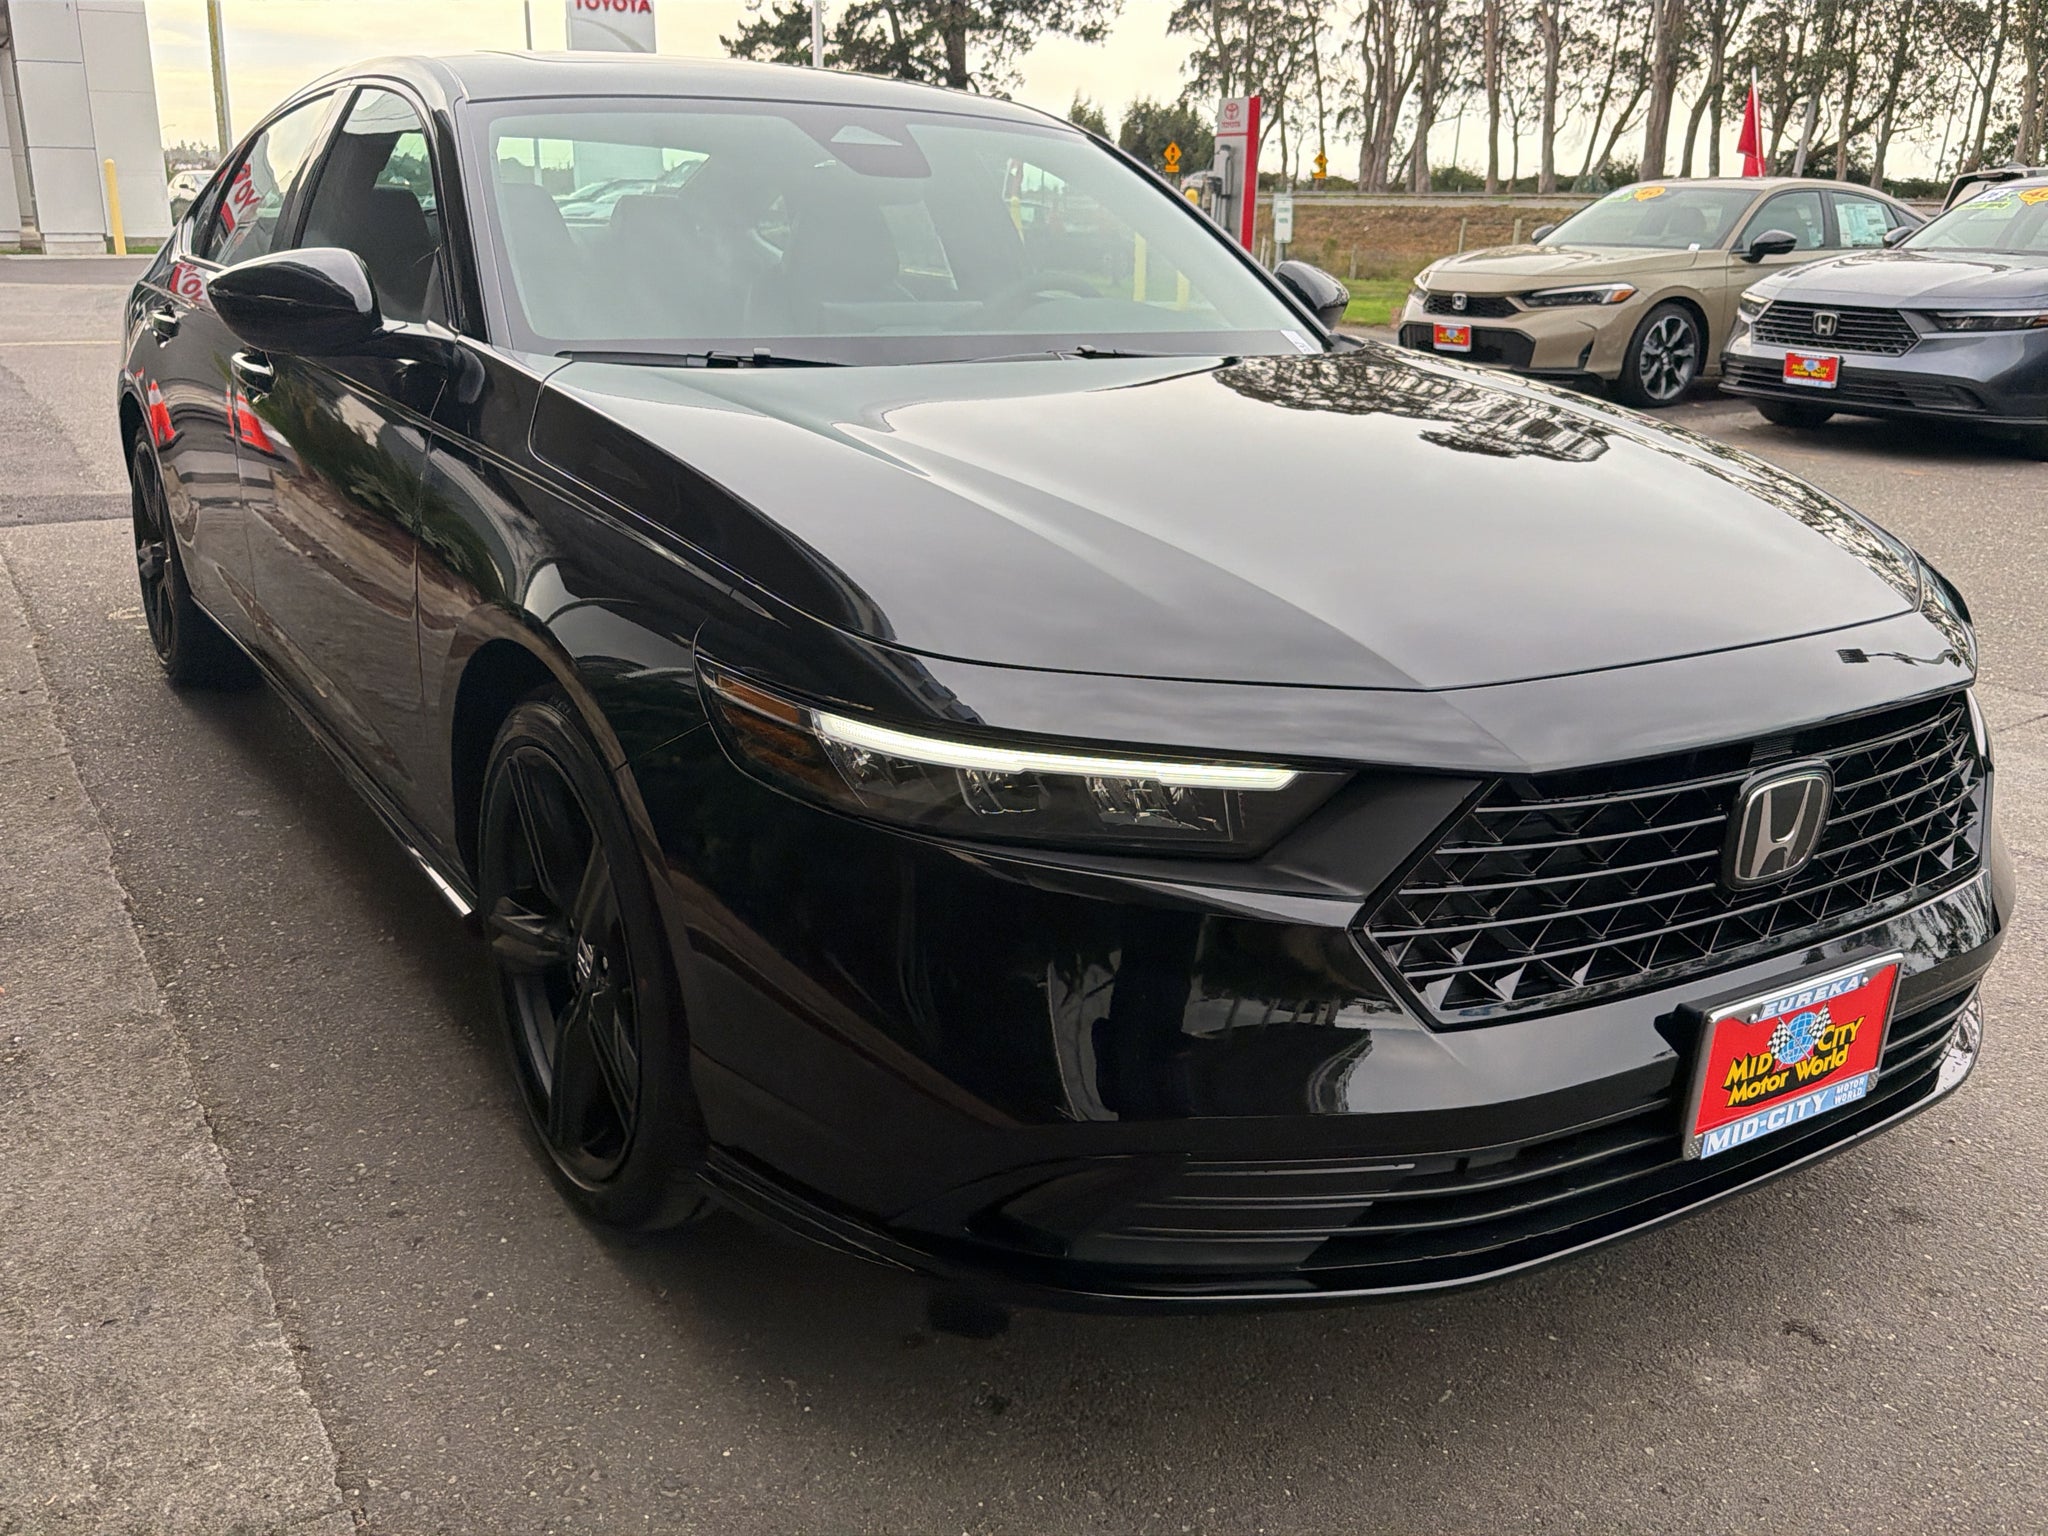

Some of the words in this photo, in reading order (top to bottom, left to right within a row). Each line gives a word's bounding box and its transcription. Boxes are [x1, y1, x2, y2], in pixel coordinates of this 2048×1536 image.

[576, 0, 652, 14] TOYOTA
[1761, 976, 1860, 1019] EUREKA
[1723, 1053, 1773, 1087] MID
[1818, 1016, 1865, 1051] CITY
[1727, 1070, 1789, 1106] Motor
[1795, 1044, 1849, 1081] World
[1834, 1087, 1863, 1105] WORLD
[1836, 1077, 1865, 1094] MOTOR
[1706, 1090, 1828, 1154] MID-CITY
